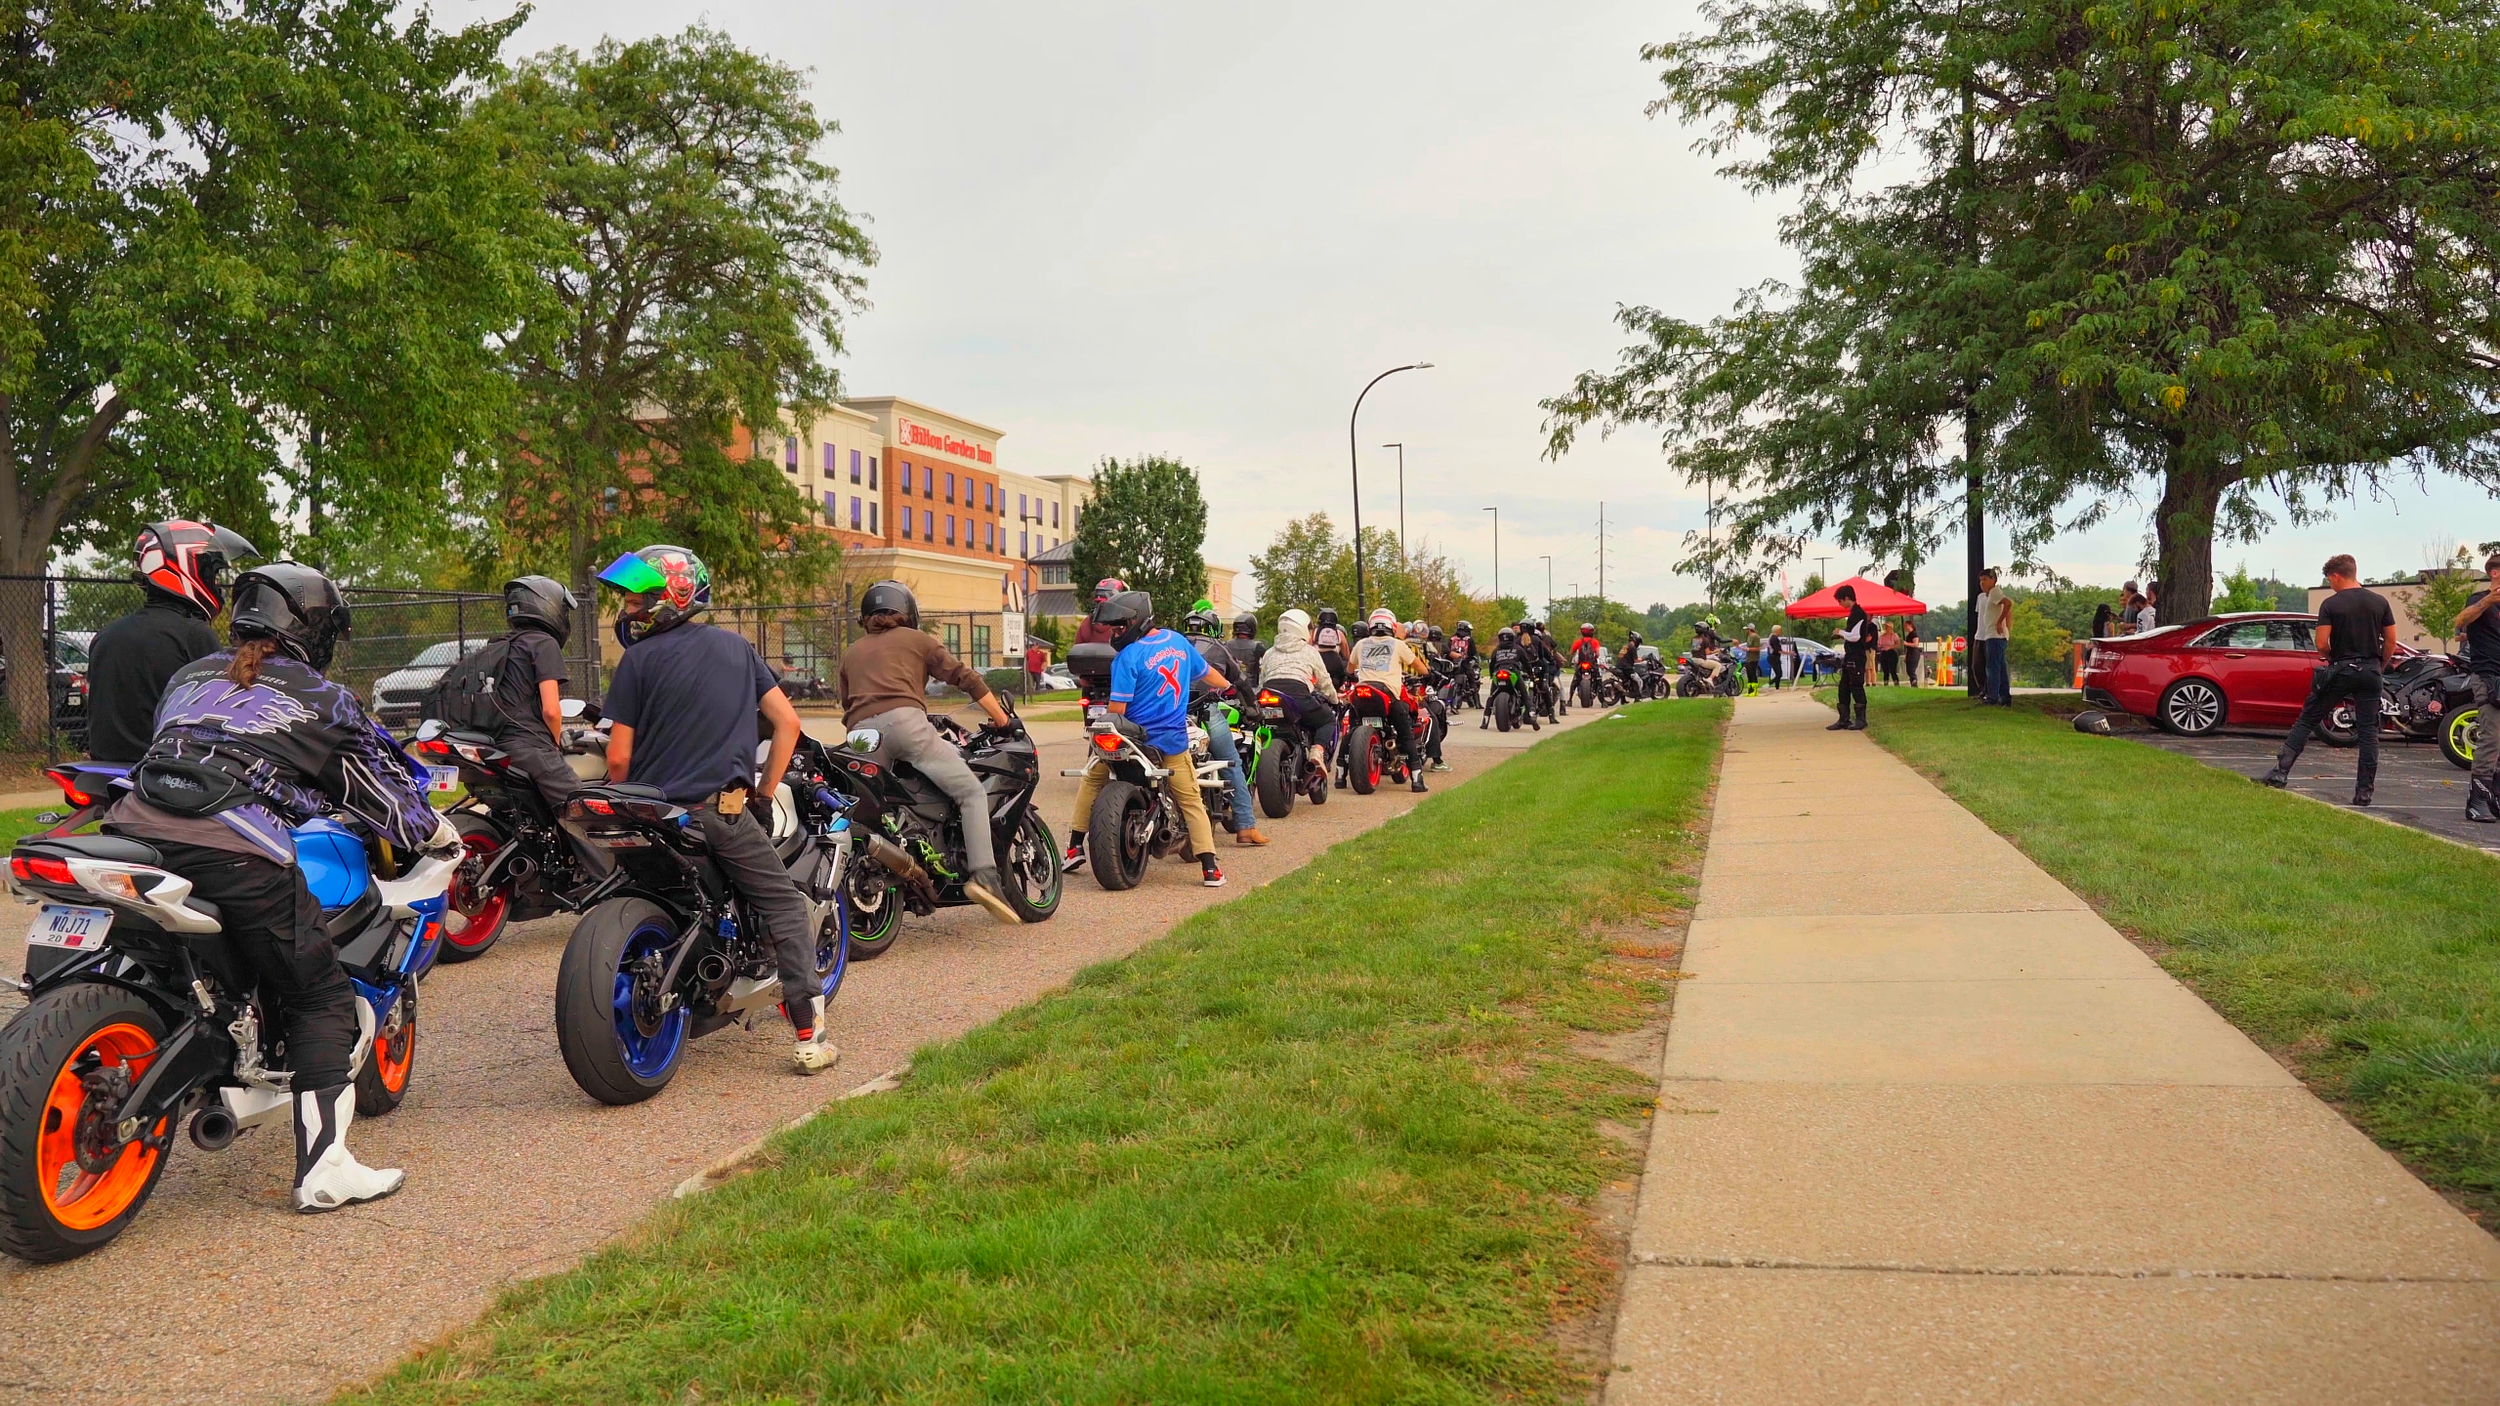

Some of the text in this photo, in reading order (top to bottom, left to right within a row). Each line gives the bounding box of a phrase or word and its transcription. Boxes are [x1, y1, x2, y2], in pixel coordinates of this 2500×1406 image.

[911, 424, 992, 464] Hilton Garden Inn
[255, 674, 288, 686] NSEEN
[49, 916, 91, 935] NQJ71
[47, 934, 63, 943] 20
